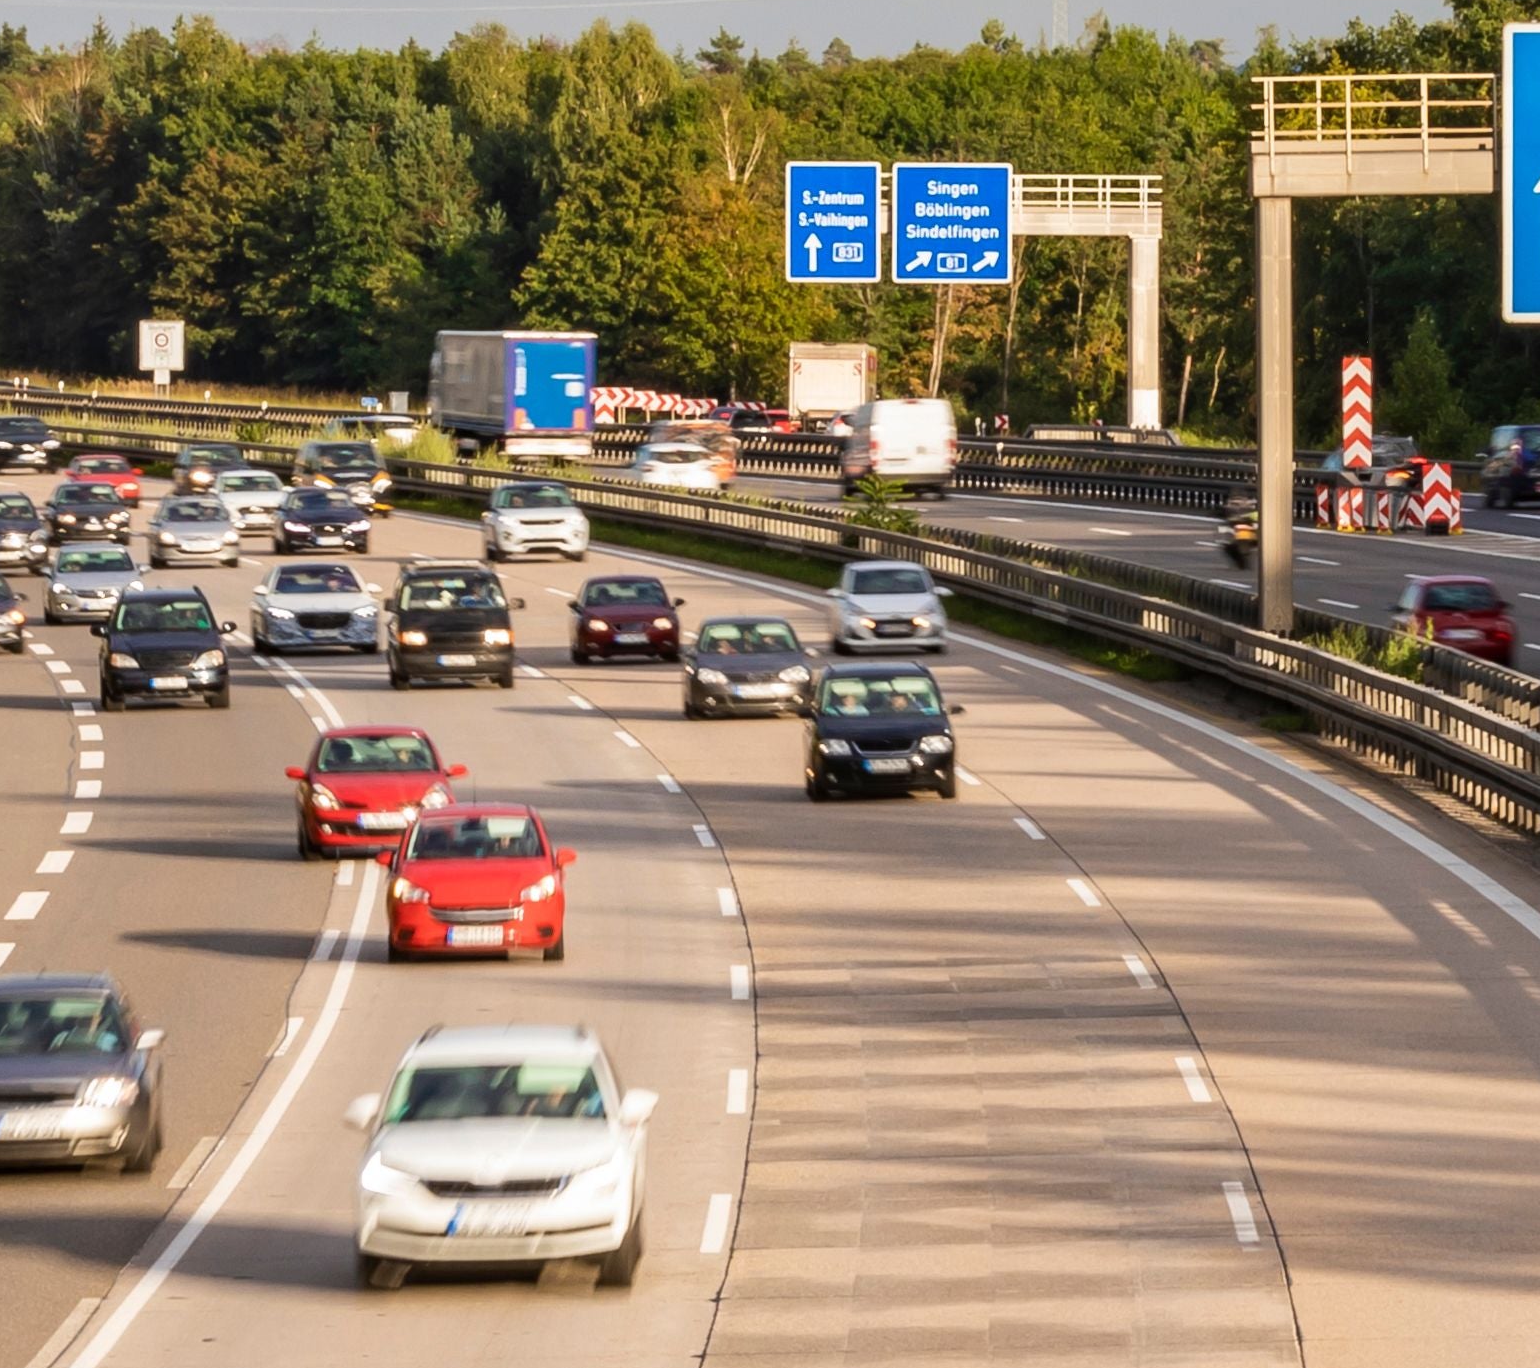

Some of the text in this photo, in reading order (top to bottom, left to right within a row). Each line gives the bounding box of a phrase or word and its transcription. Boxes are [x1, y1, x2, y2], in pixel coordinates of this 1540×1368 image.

[927, 180, 979, 199] Singen
[915, 202, 990, 220] Böblingen
[906, 224, 1000, 242] Sindelfingen
[838, 246, 858, 259] 831
[945, 256, 958, 269] 81
